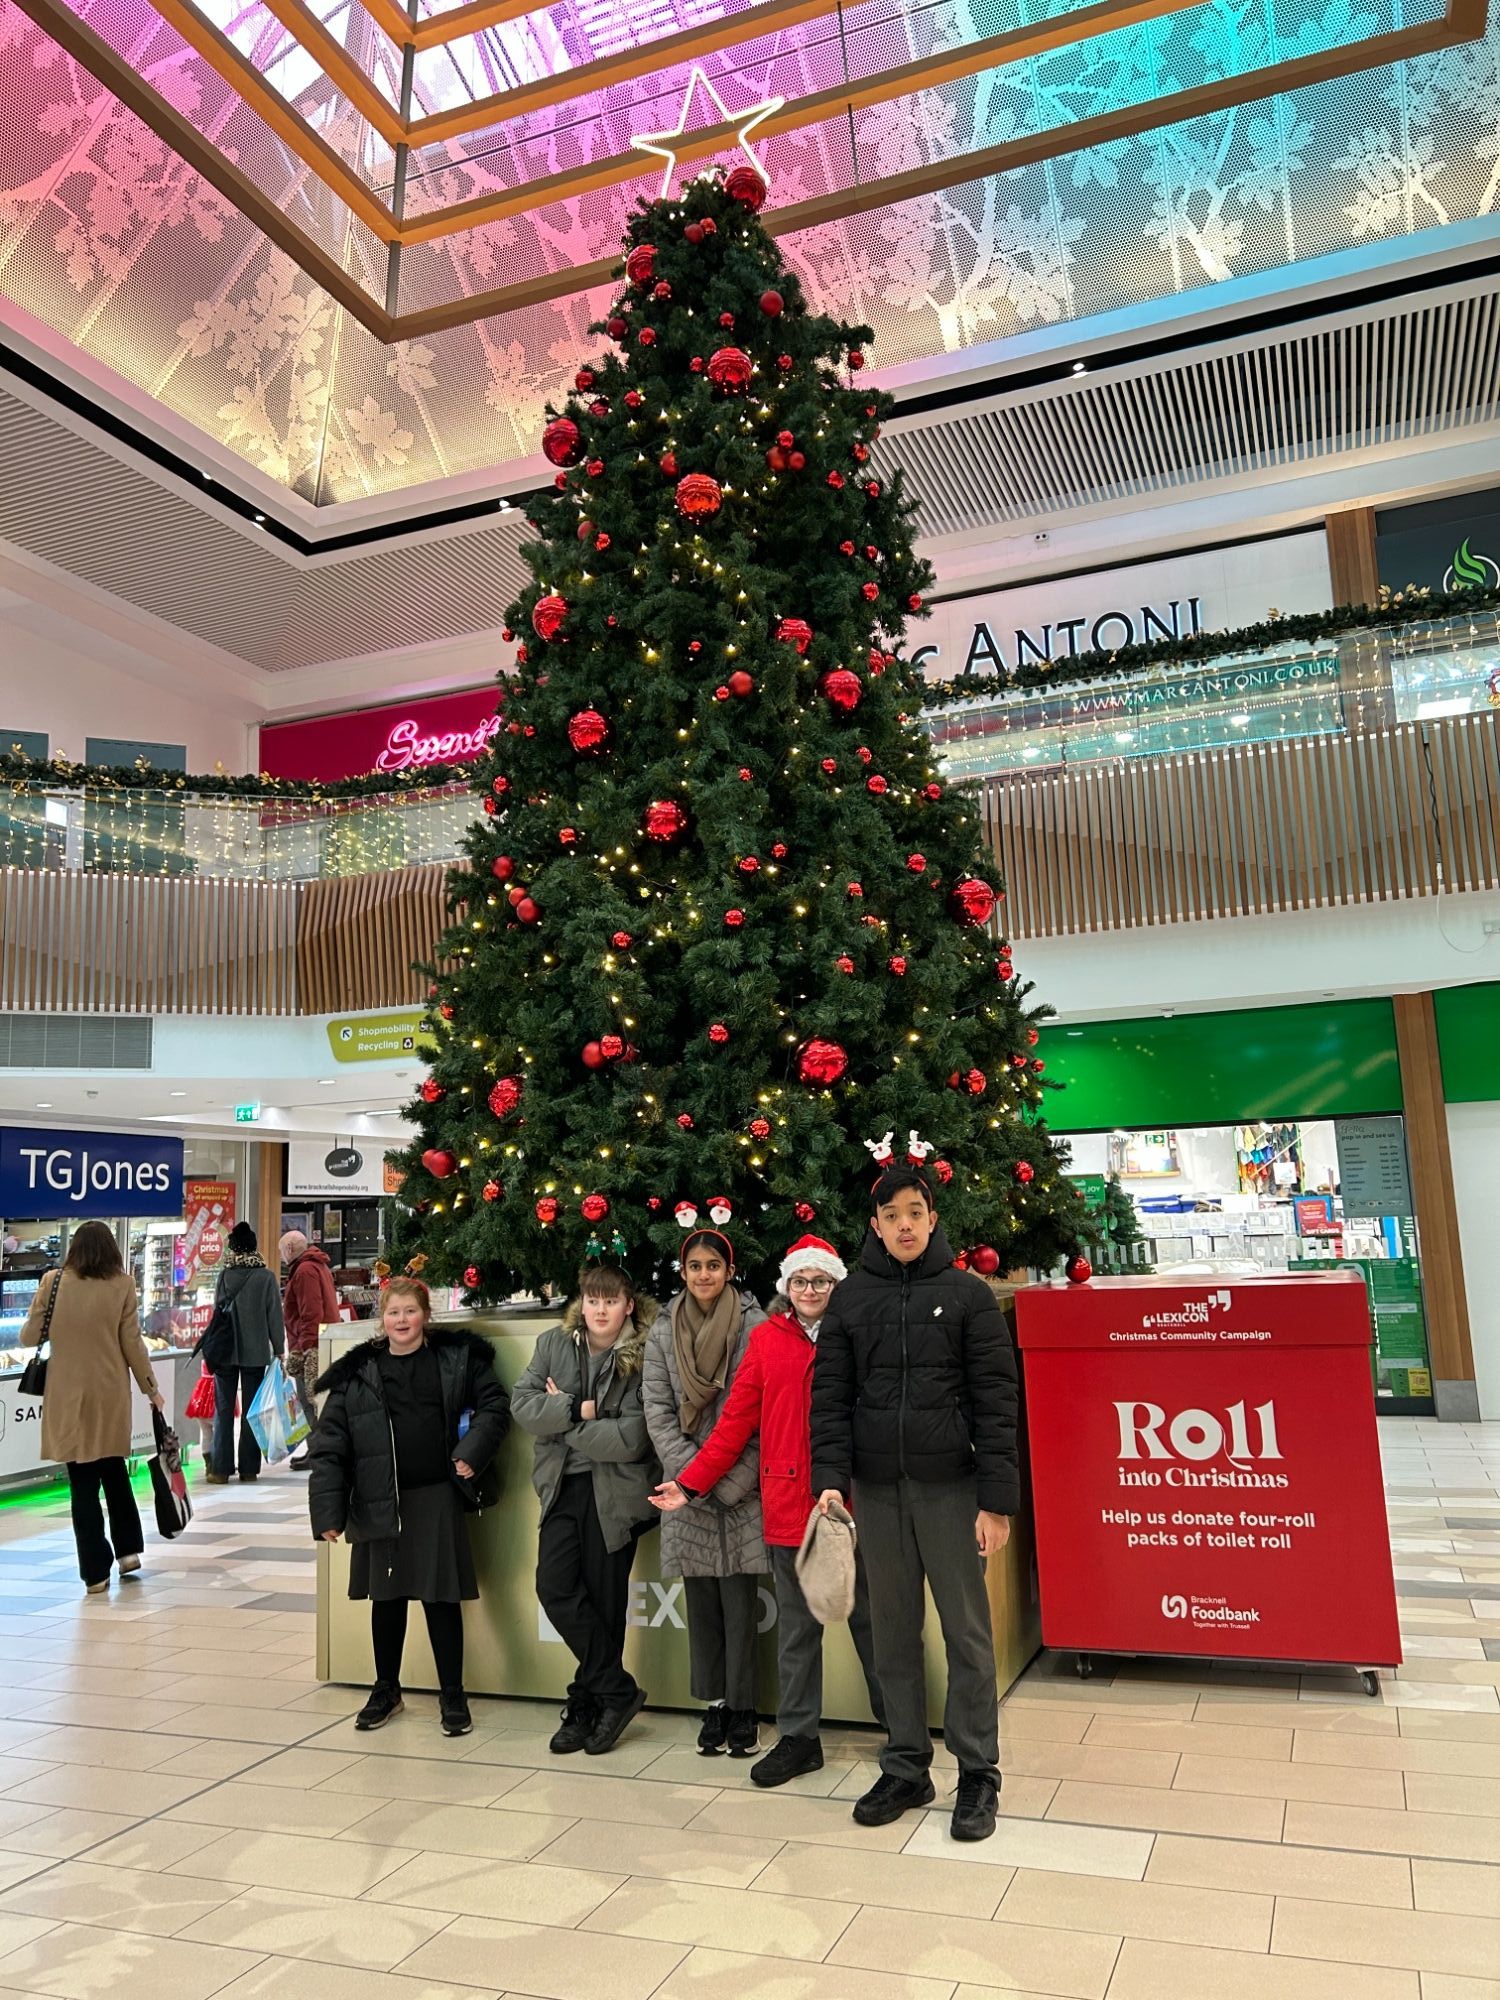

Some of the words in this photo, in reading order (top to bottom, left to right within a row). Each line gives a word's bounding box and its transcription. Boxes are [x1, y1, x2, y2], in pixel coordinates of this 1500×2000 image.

[963, 597, 1201, 674] ANTONI
[358, 1023, 415, 1036] Shopmobility
[358, 1041, 399, 1052] Recycling
[20, 1148, 170, 1201] TGJones
[193, 1185, 229, 1194] Christmas
[202, 1232, 219, 1242] Half
[200, 1243, 221, 1254] price
[1183, 1302, 1208, 1313] THE
[1156, 1312, 1209, 1324] LEXICON
[183, 1325, 207, 1341] pric
[1109, 1332, 1158, 1341] Christmas
[1160, 1332, 1217, 1342] Community
[1219, 1330, 1272, 1341] Campaign
[1112, 1399, 1285, 1471] Roll
[1118, 1466, 1162, 1486] into
[1165, 1466, 1289, 1488] Christmas
[1101, 1509, 1142, 1527] Help
[1147, 1513, 1167, 1525] us
[1171, 1510, 1234, 1526] donate
[1239, 1511, 1316, 1528] four-roll
[1127, 1531, 1178, 1548] packs
[1183, 1531, 1202, 1546] of
[1206, 1532, 1256, 1548] toilet
[1260, 1533, 1292, 1549] roll
[1191, 1595, 1227, 1605] Bracknell
[1191, 1605, 1261, 1622] Foodbank
[1193, 1621, 1216, 1629] Together
